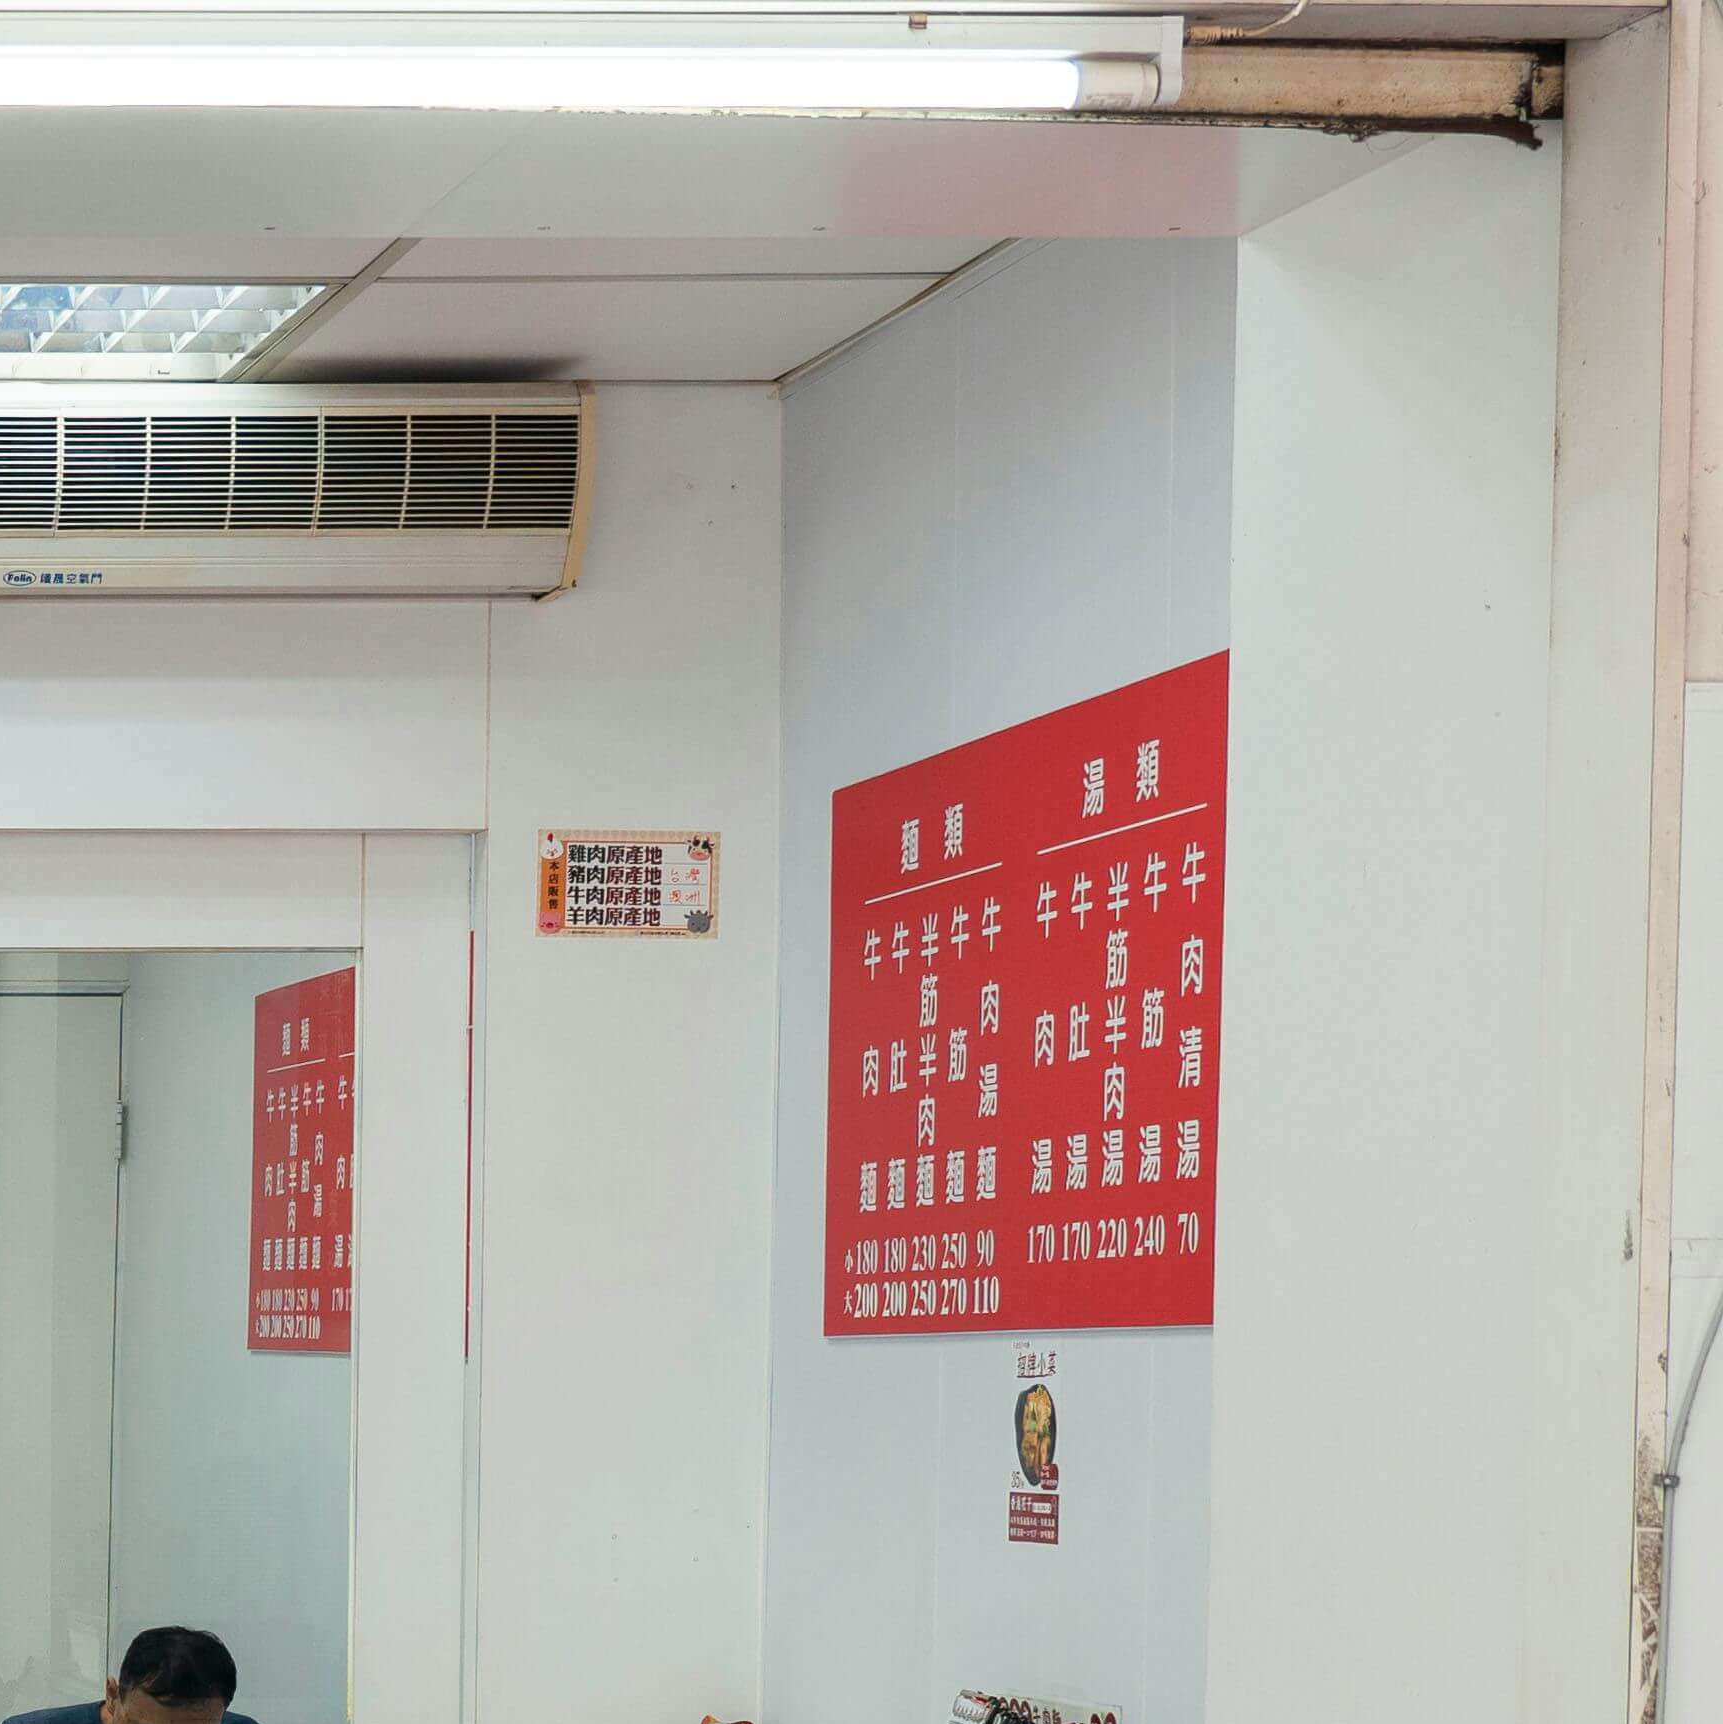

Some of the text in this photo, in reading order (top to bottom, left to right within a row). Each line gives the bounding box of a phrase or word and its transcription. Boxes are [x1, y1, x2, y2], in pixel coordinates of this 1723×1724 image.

[1082, 739, 1161, 818] 湯類
[567, 865, 662, 885] 豬肉原產地
[568, 845, 663, 865] 雞肉原產地
[900, 803, 963, 874] 麵類
[567, 886, 661, 906] 牛肉原產地
[567, 907, 661, 927] 羊肉原產地
[946, 904, 970, 1205] 牛筋麵
[1031, 881, 1057, 1195] 牛肉湯
[1066, 871, 1093, 1191] 牛肚湯
[1138, 851, 1168, 1184] 牛筋湯
[860, 928, 882, 1213] 牛肉麵
[887, 921, 909, 1211] 牛肚麵
[856, 1239, 878, 1275] 180
[883, 1237, 906, 1273] 180
[911, 1234, 937, 1272] 230
[941, 1231, 967, 1270] 250
[976, 1229, 995, 1268] 90
[1028, 1224, 1054, 1263] 170
[1063, 1221, 1090, 1260] 170
[1097, 1218, 1127, 1259] 220
[1134, 1215, 1165, 1256] 240
[1177, 1212, 1199, 1254] 70
[854, 1283, 878, 1318] 200
[882, 1281, 906, 1317] 200
[910, 1279, 937, 1316] 250
[940, 1278, 967, 1315] 270
[972, 1276, 1000, 1315] 110
